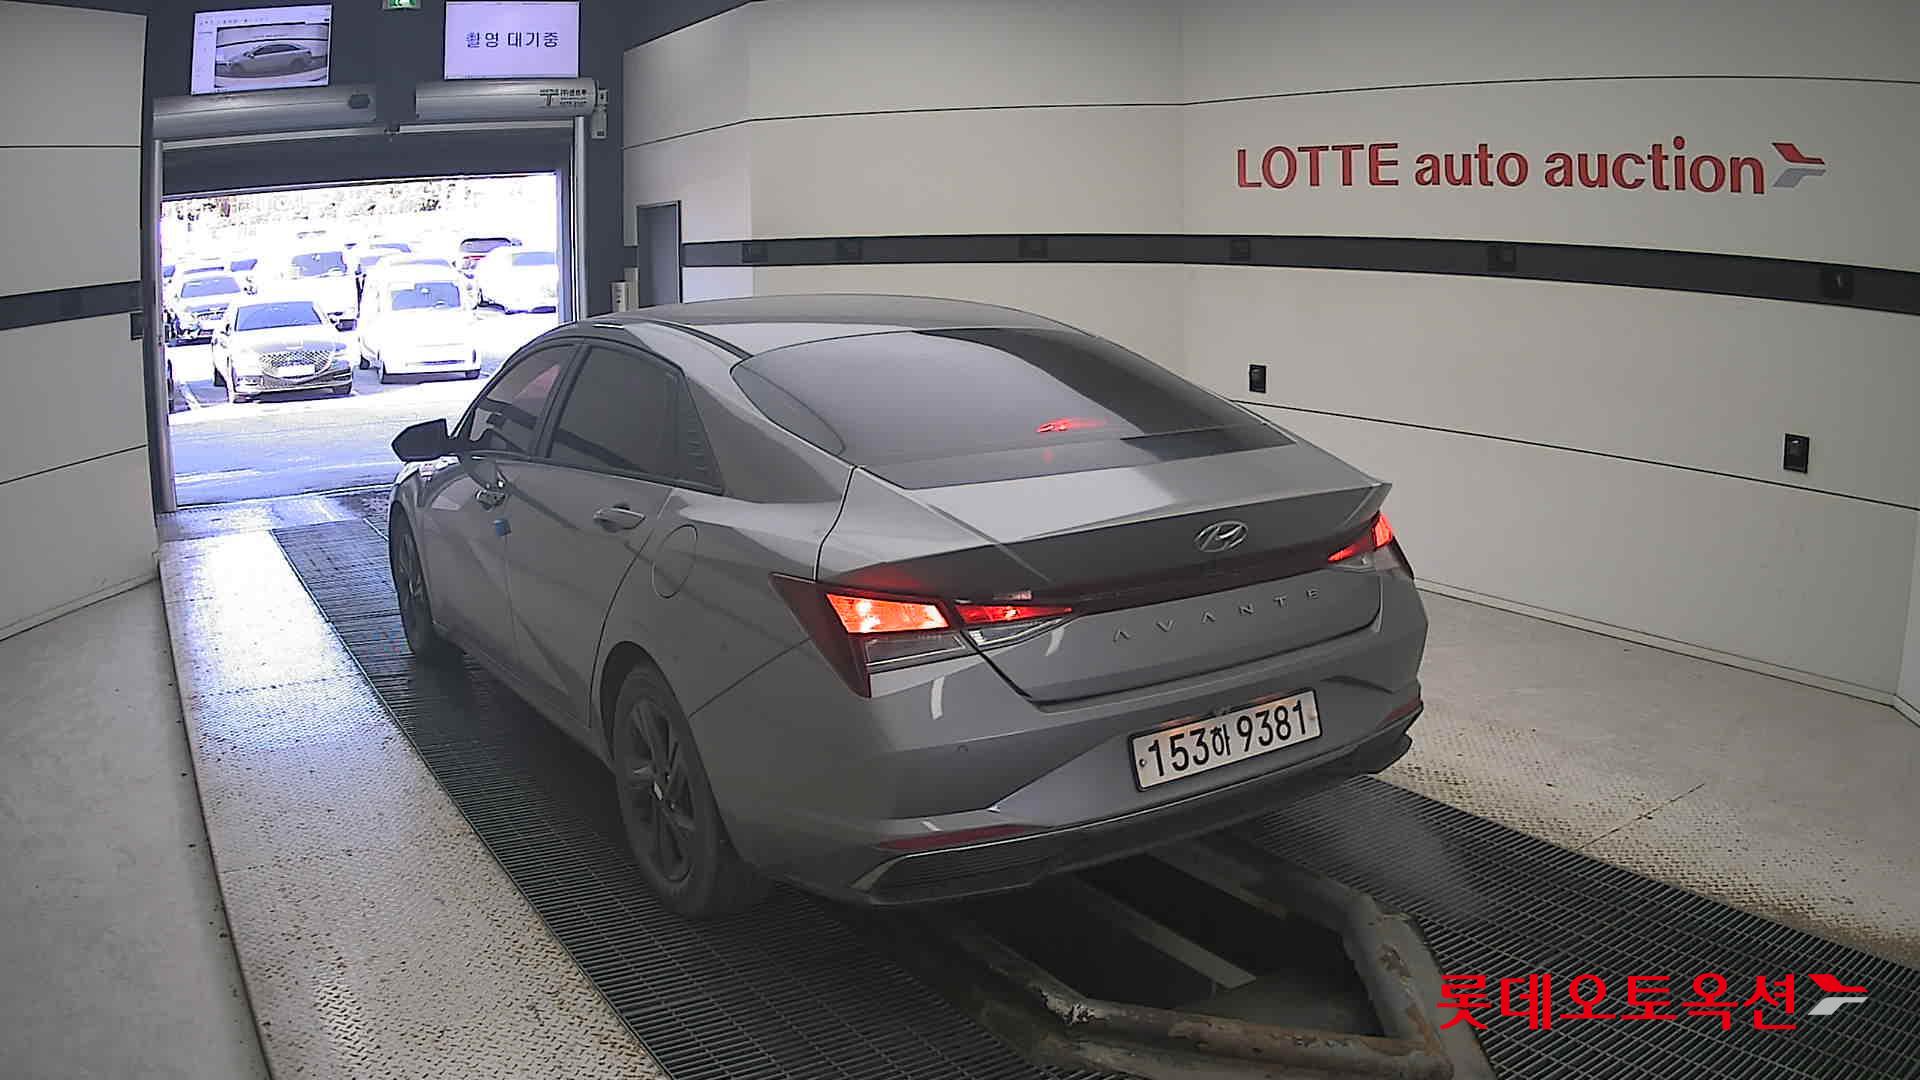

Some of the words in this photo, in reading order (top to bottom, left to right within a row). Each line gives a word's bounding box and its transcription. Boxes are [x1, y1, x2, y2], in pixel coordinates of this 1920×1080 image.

[507, 31, 560, 48] 대기중
[1238, 143, 1399, 188] LOTTE
[1415, 143, 1529, 187] auto
[1545, 137, 1766, 194] auction
[1113, 588, 1321, 643] AVANTE
[1148, 723, 1232, 778] 153하
[1236, 699, 1308, 754] 9381
